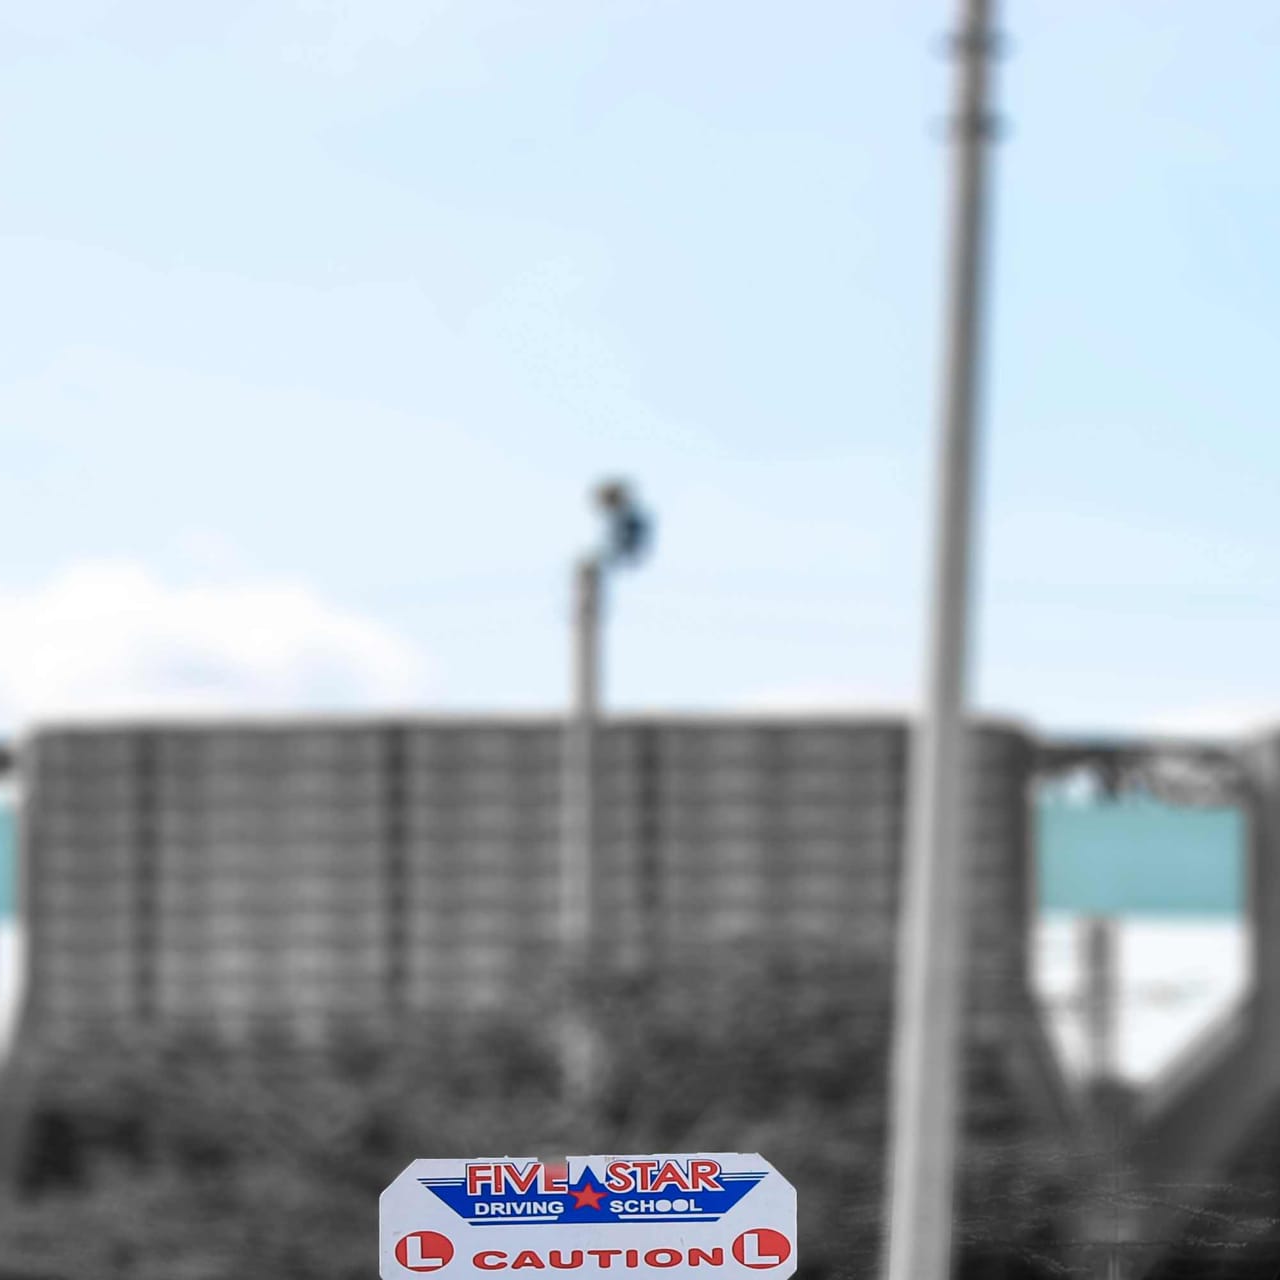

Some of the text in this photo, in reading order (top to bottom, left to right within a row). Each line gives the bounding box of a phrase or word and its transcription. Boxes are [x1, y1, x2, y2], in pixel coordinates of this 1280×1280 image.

[465, 1158, 726, 1196] FIVE STAR
[474, 1199, 703, 1216] DRIVING SCHOOL
[406, 1234, 780, 1270] L CAUTION L
